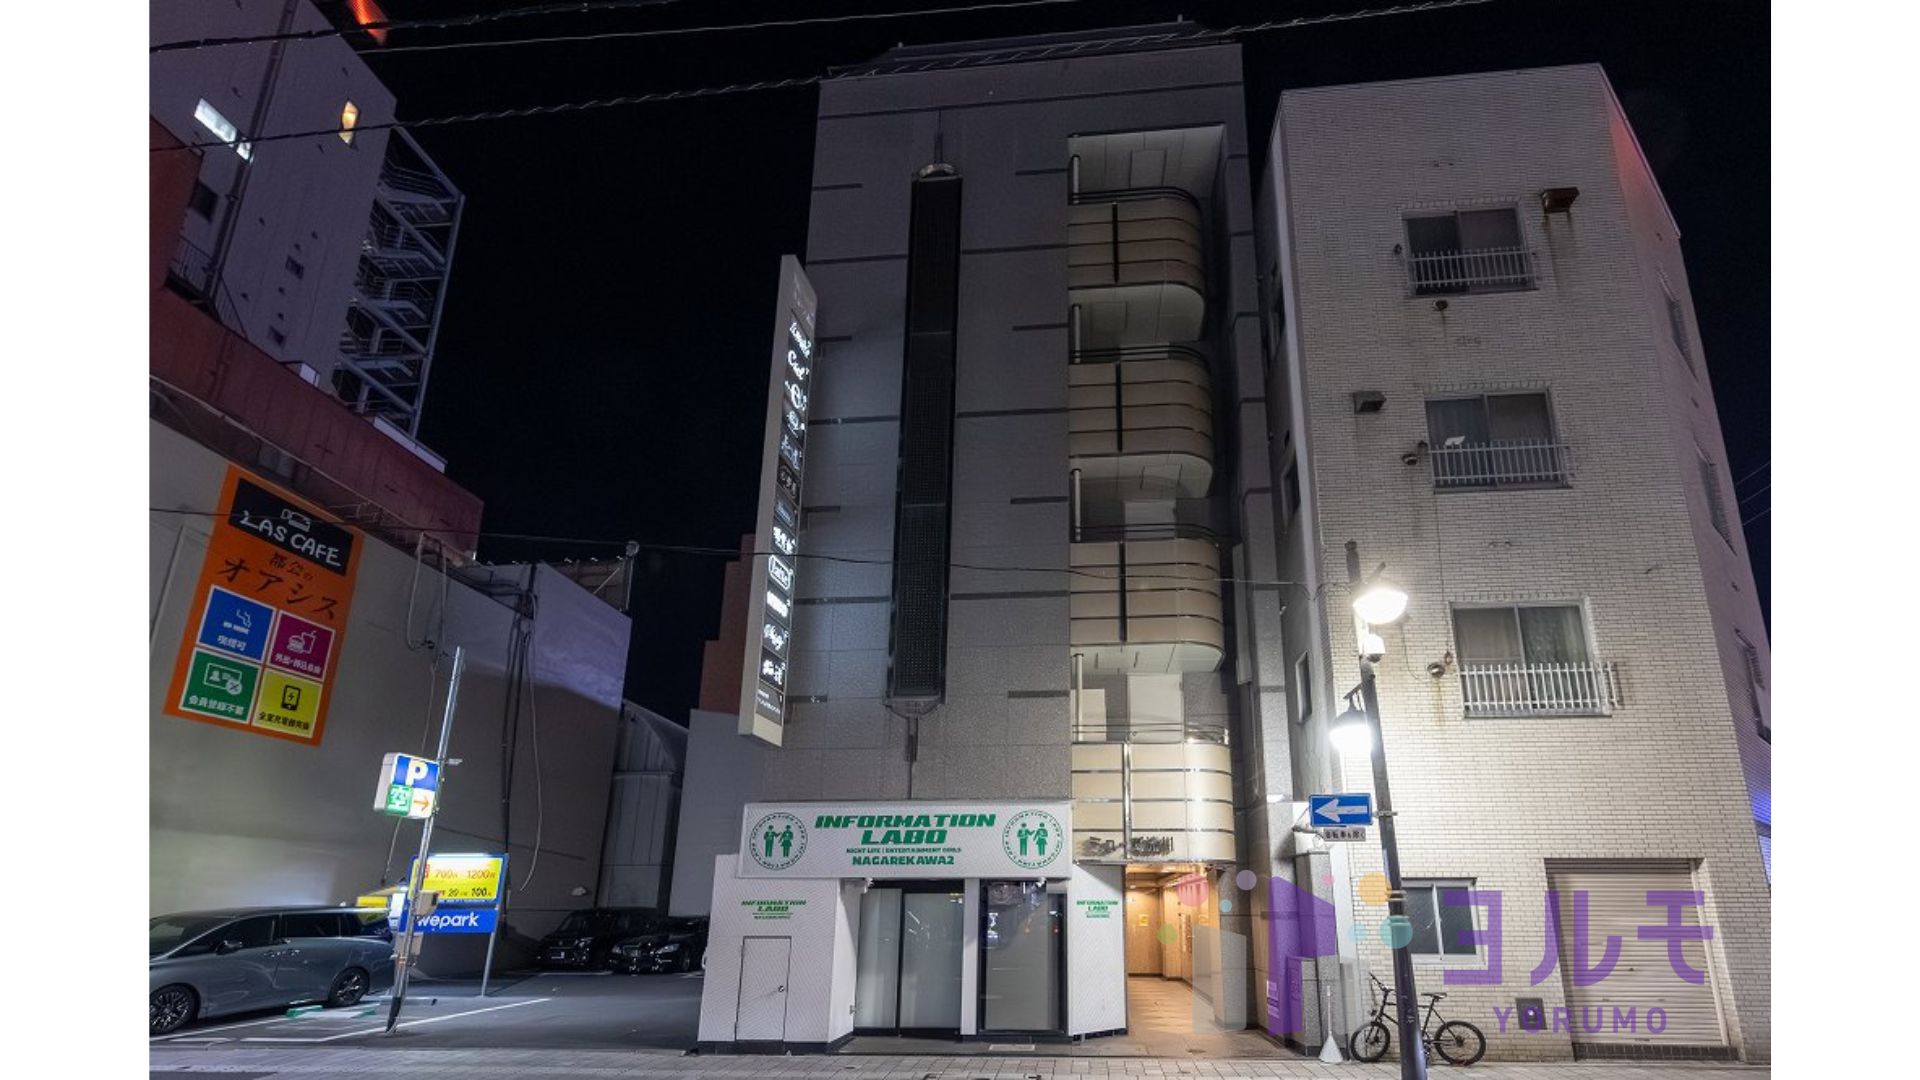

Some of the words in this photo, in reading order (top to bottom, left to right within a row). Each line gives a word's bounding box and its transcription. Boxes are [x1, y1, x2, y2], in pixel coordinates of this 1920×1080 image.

[239, 510, 288, 542] LAS
[290, 533, 342, 567] CAFE
[216, 558, 338, 620] オアシス
[405, 759, 429, 786] P
[814, 813, 997, 828] INFORMATION
[861, 829, 948, 845] LABO
[852, 855, 955, 865] NAGAREKAWA2
[417, 911, 480, 930] wepark
